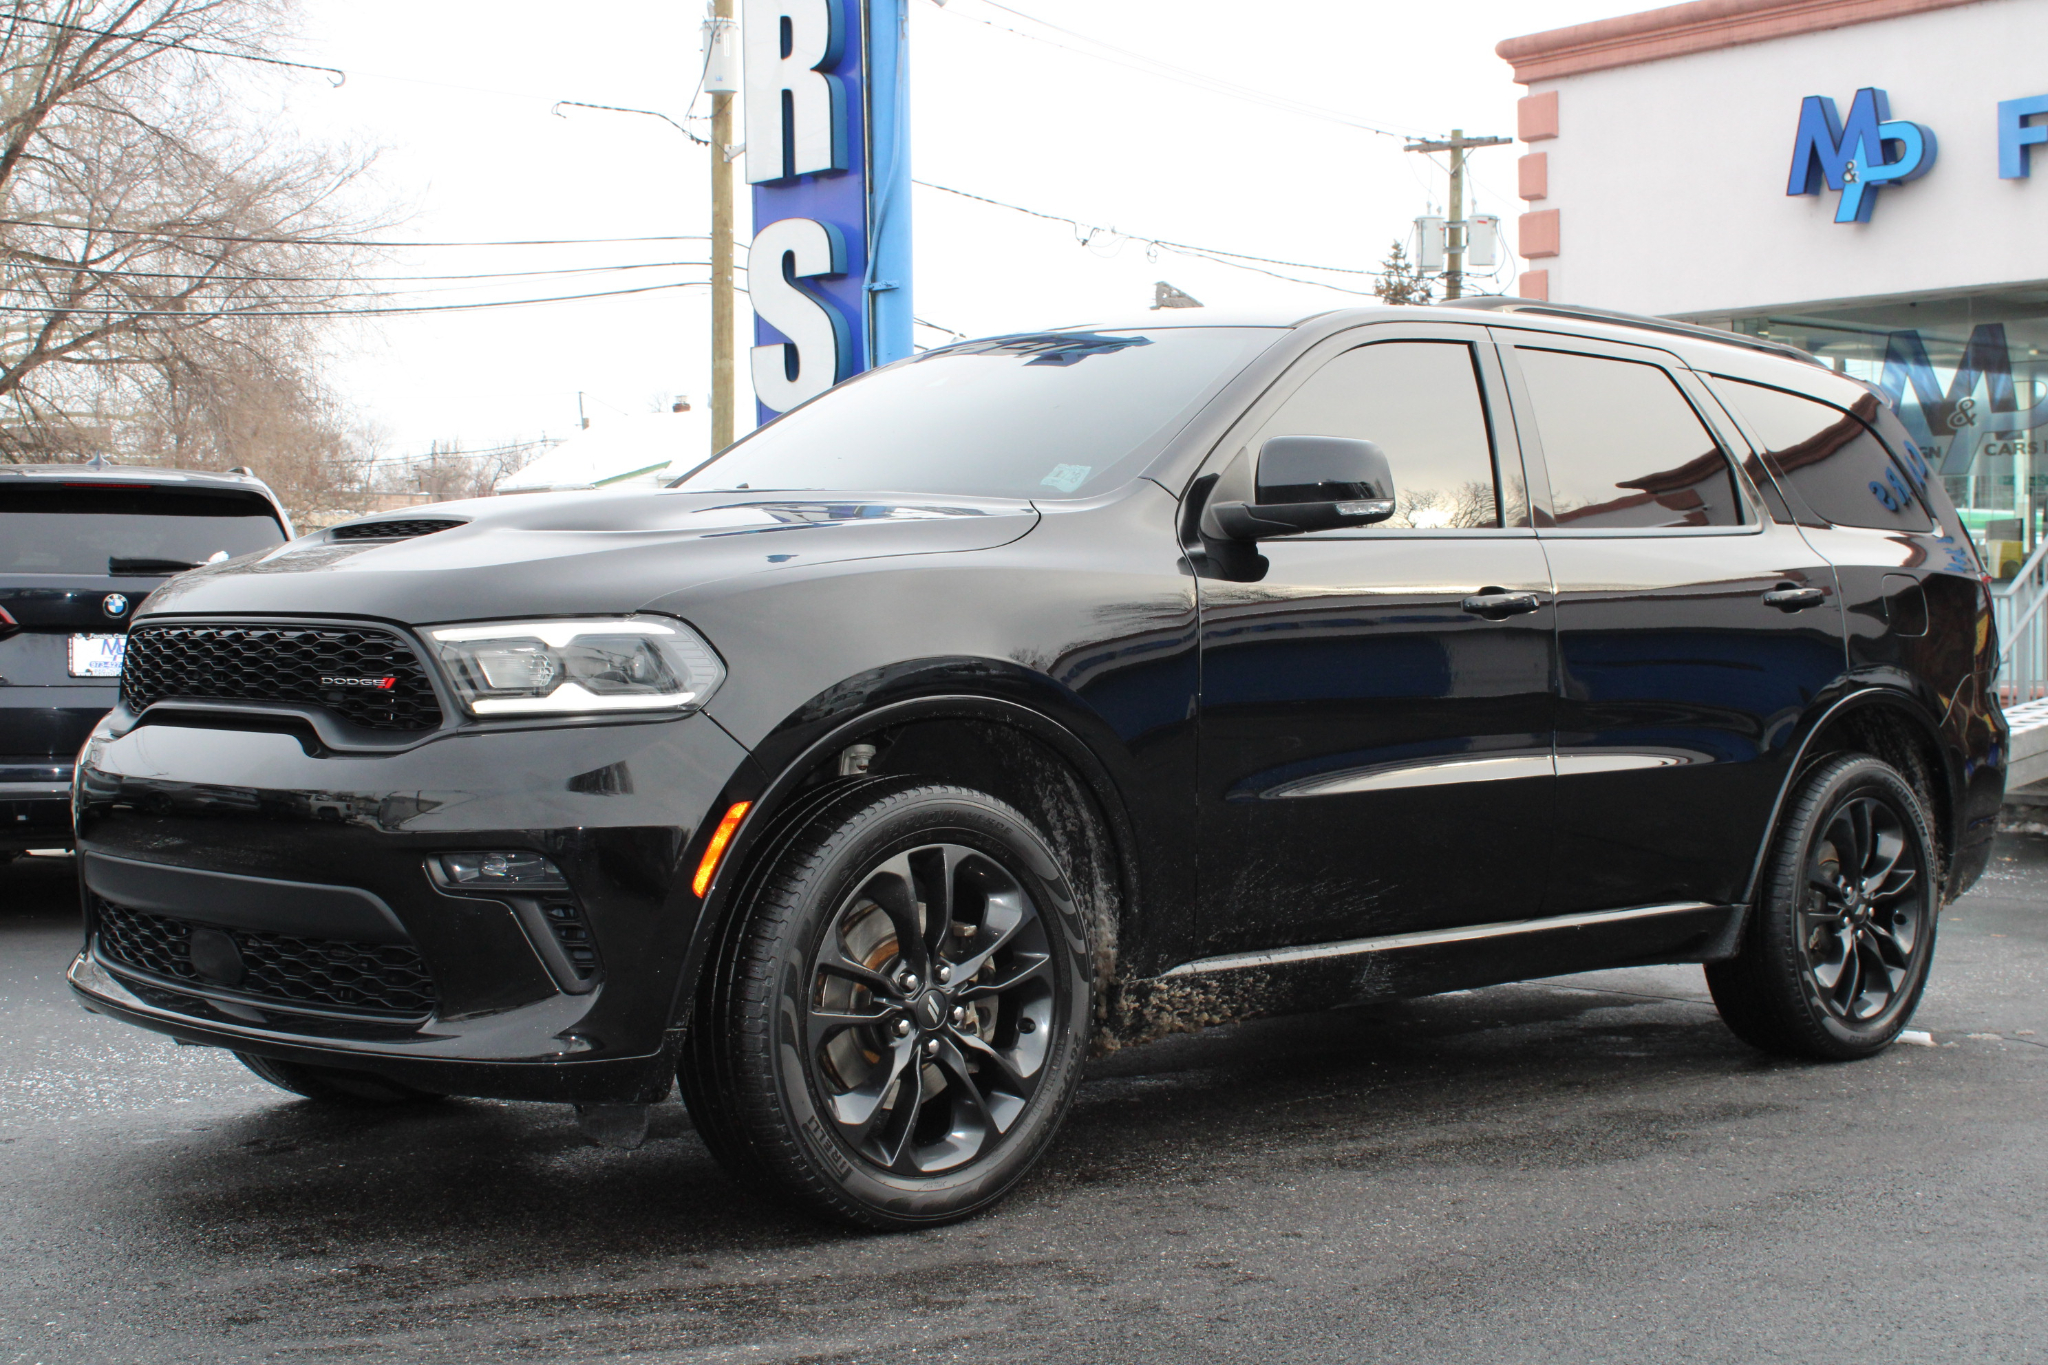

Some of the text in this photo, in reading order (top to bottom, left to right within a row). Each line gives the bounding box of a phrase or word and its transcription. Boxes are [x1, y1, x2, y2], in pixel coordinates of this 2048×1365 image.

[1984, 441, 2038, 456] CARS
[321, 677, 386, 687] DODGE
[802, 1115, 854, 1182] PIRELLI
